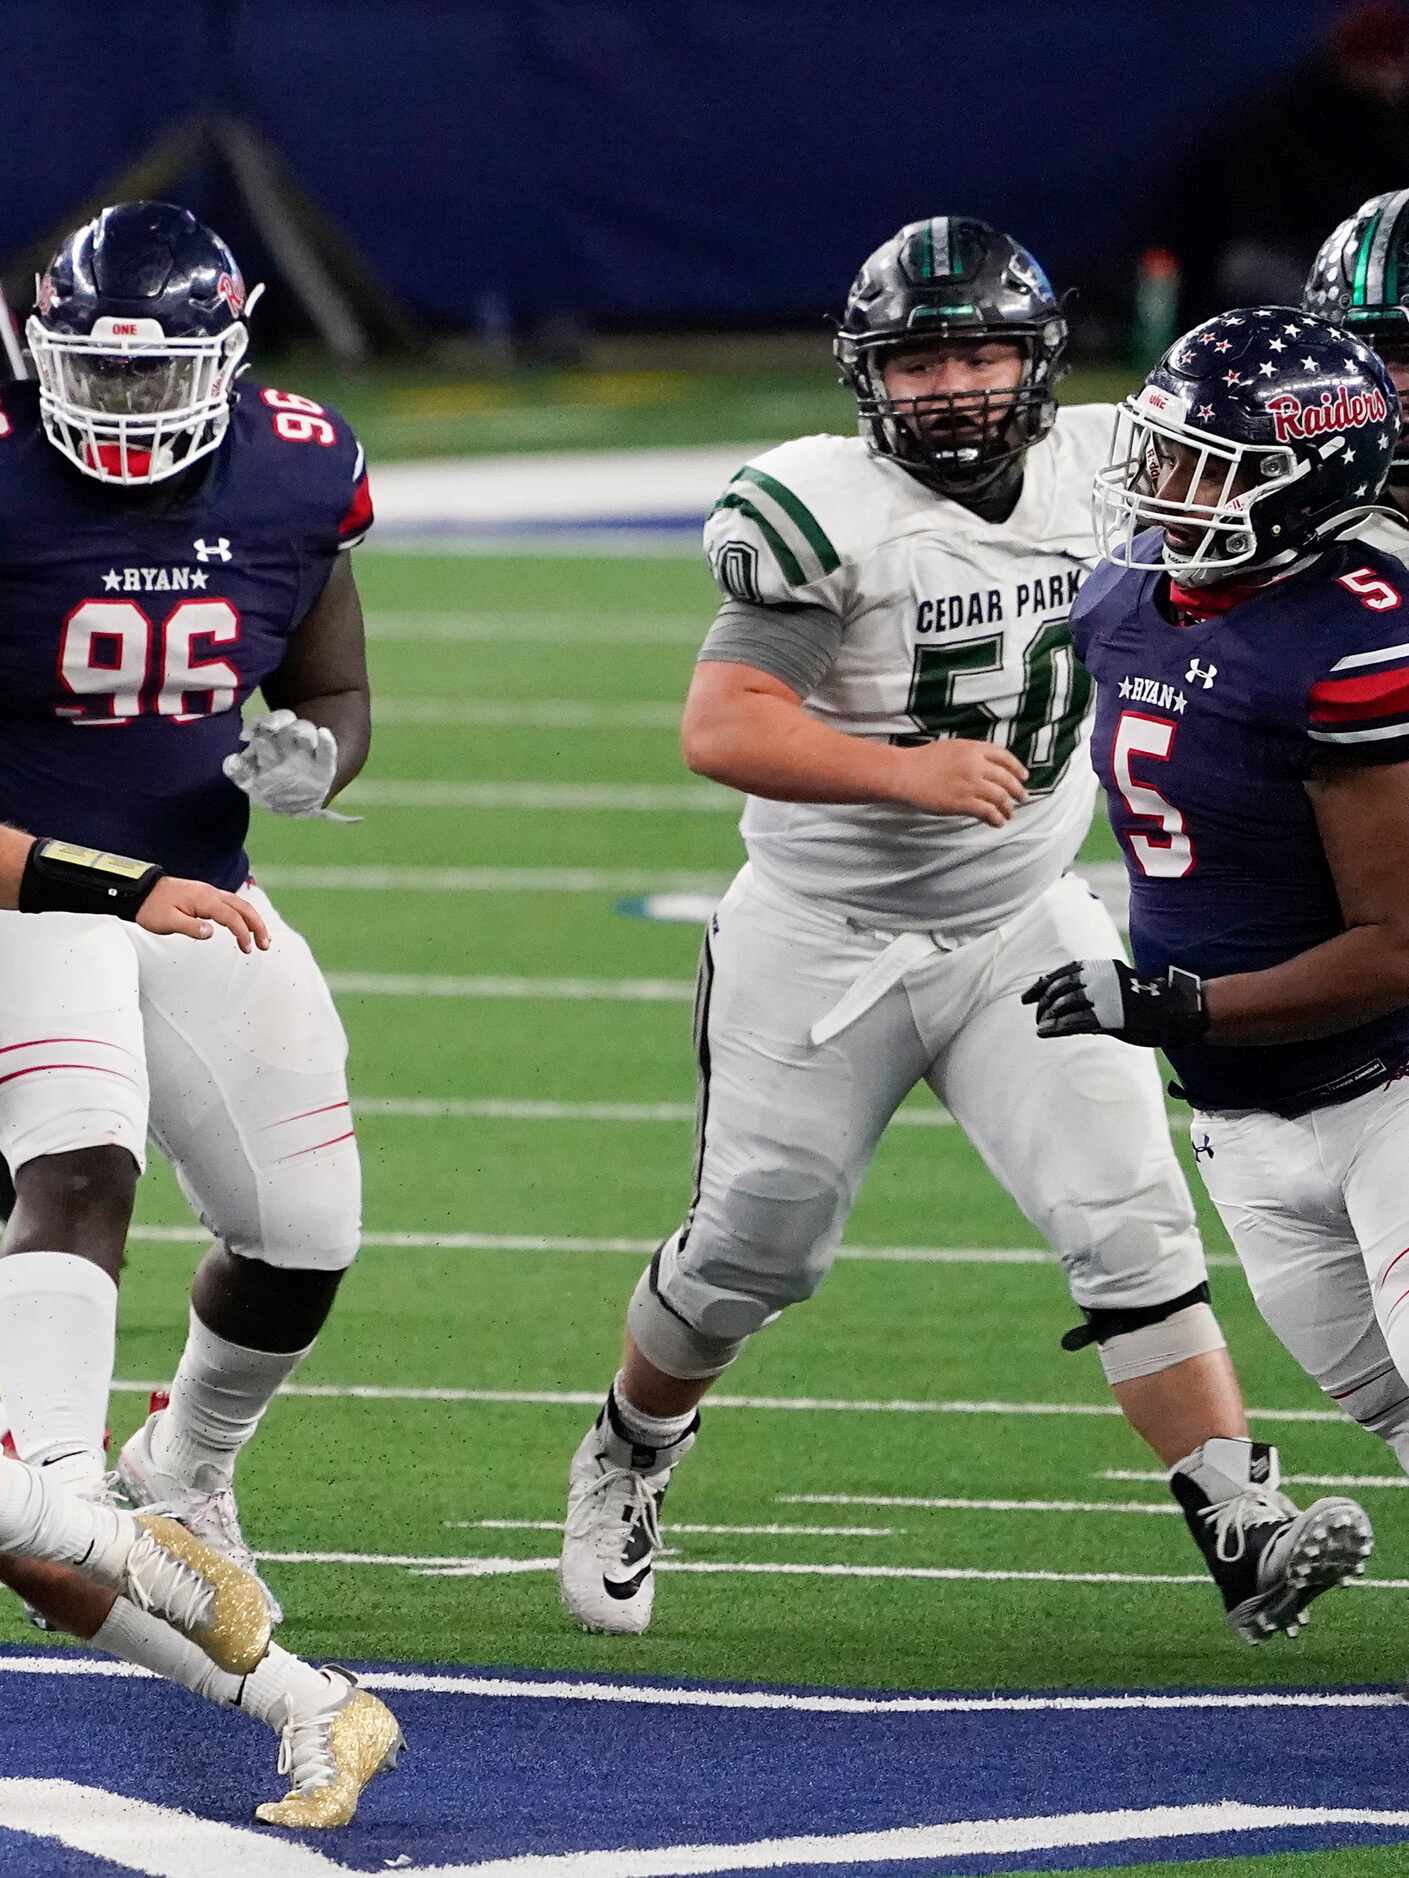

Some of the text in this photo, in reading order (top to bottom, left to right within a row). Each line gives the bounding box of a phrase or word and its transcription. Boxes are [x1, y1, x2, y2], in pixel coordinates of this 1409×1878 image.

[112, 323, 137, 336] ONE
[259, 386, 337, 448] 96
[1265, 385, 1388, 442] Raiders
[122, 566, 190, 592] RYAN
[916, 568, 1082, 634] CEDAR PARK
[1334, 566, 1403, 613] 5
[54, 597, 241, 728] 96
[904, 615, 1096, 798] 50
[1130, 676, 1175, 710] RYAN
[1111, 709, 1198, 879] 5
